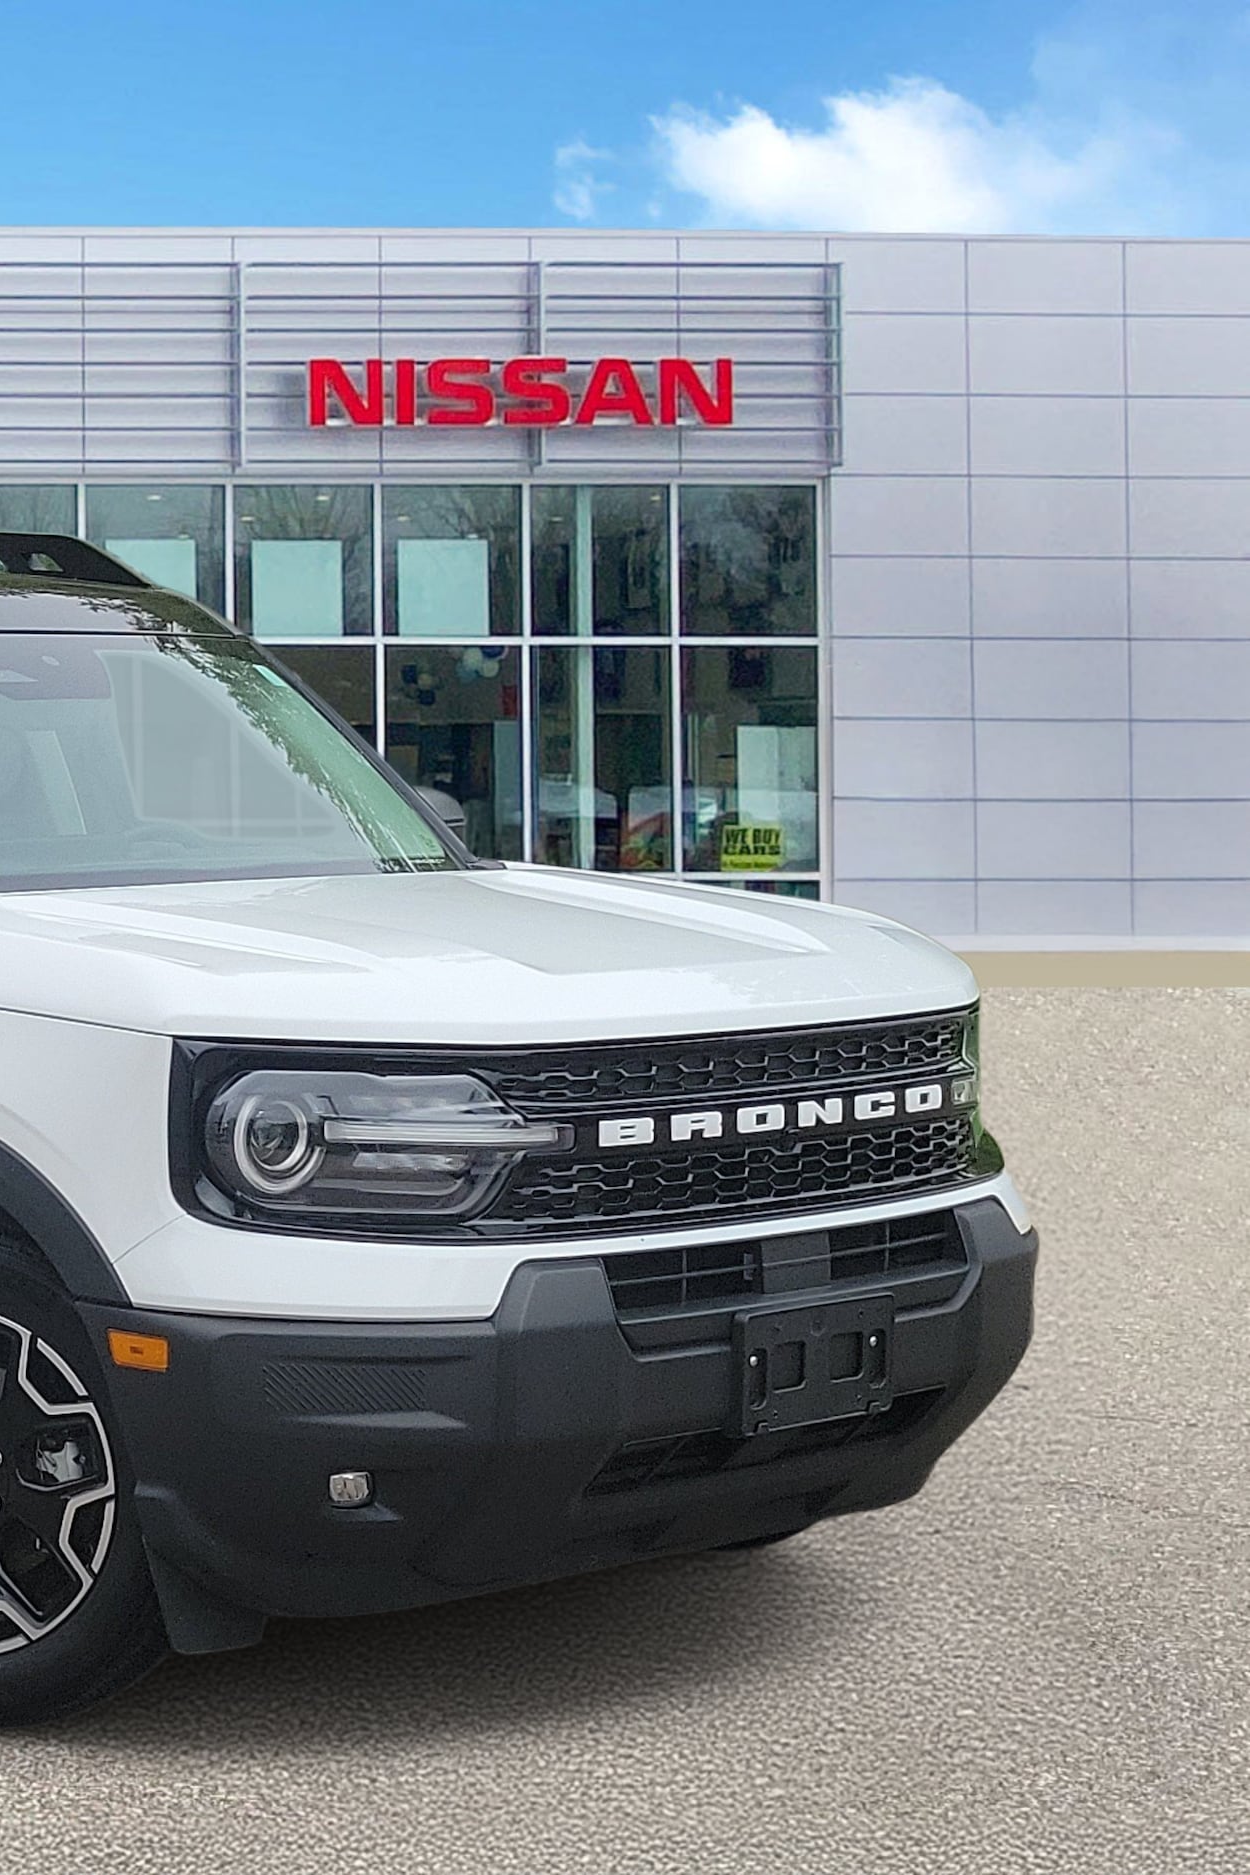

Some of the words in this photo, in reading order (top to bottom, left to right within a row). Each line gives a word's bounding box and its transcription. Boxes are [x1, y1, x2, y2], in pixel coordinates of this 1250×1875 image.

[309, 358, 733, 426] NISSAN
[724, 845, 781, 856] CARS
[725, 829, 748, 845] WE
[753, 828, 780, 845] BUY
[598, 1084, 943, 1148] BRONCO
